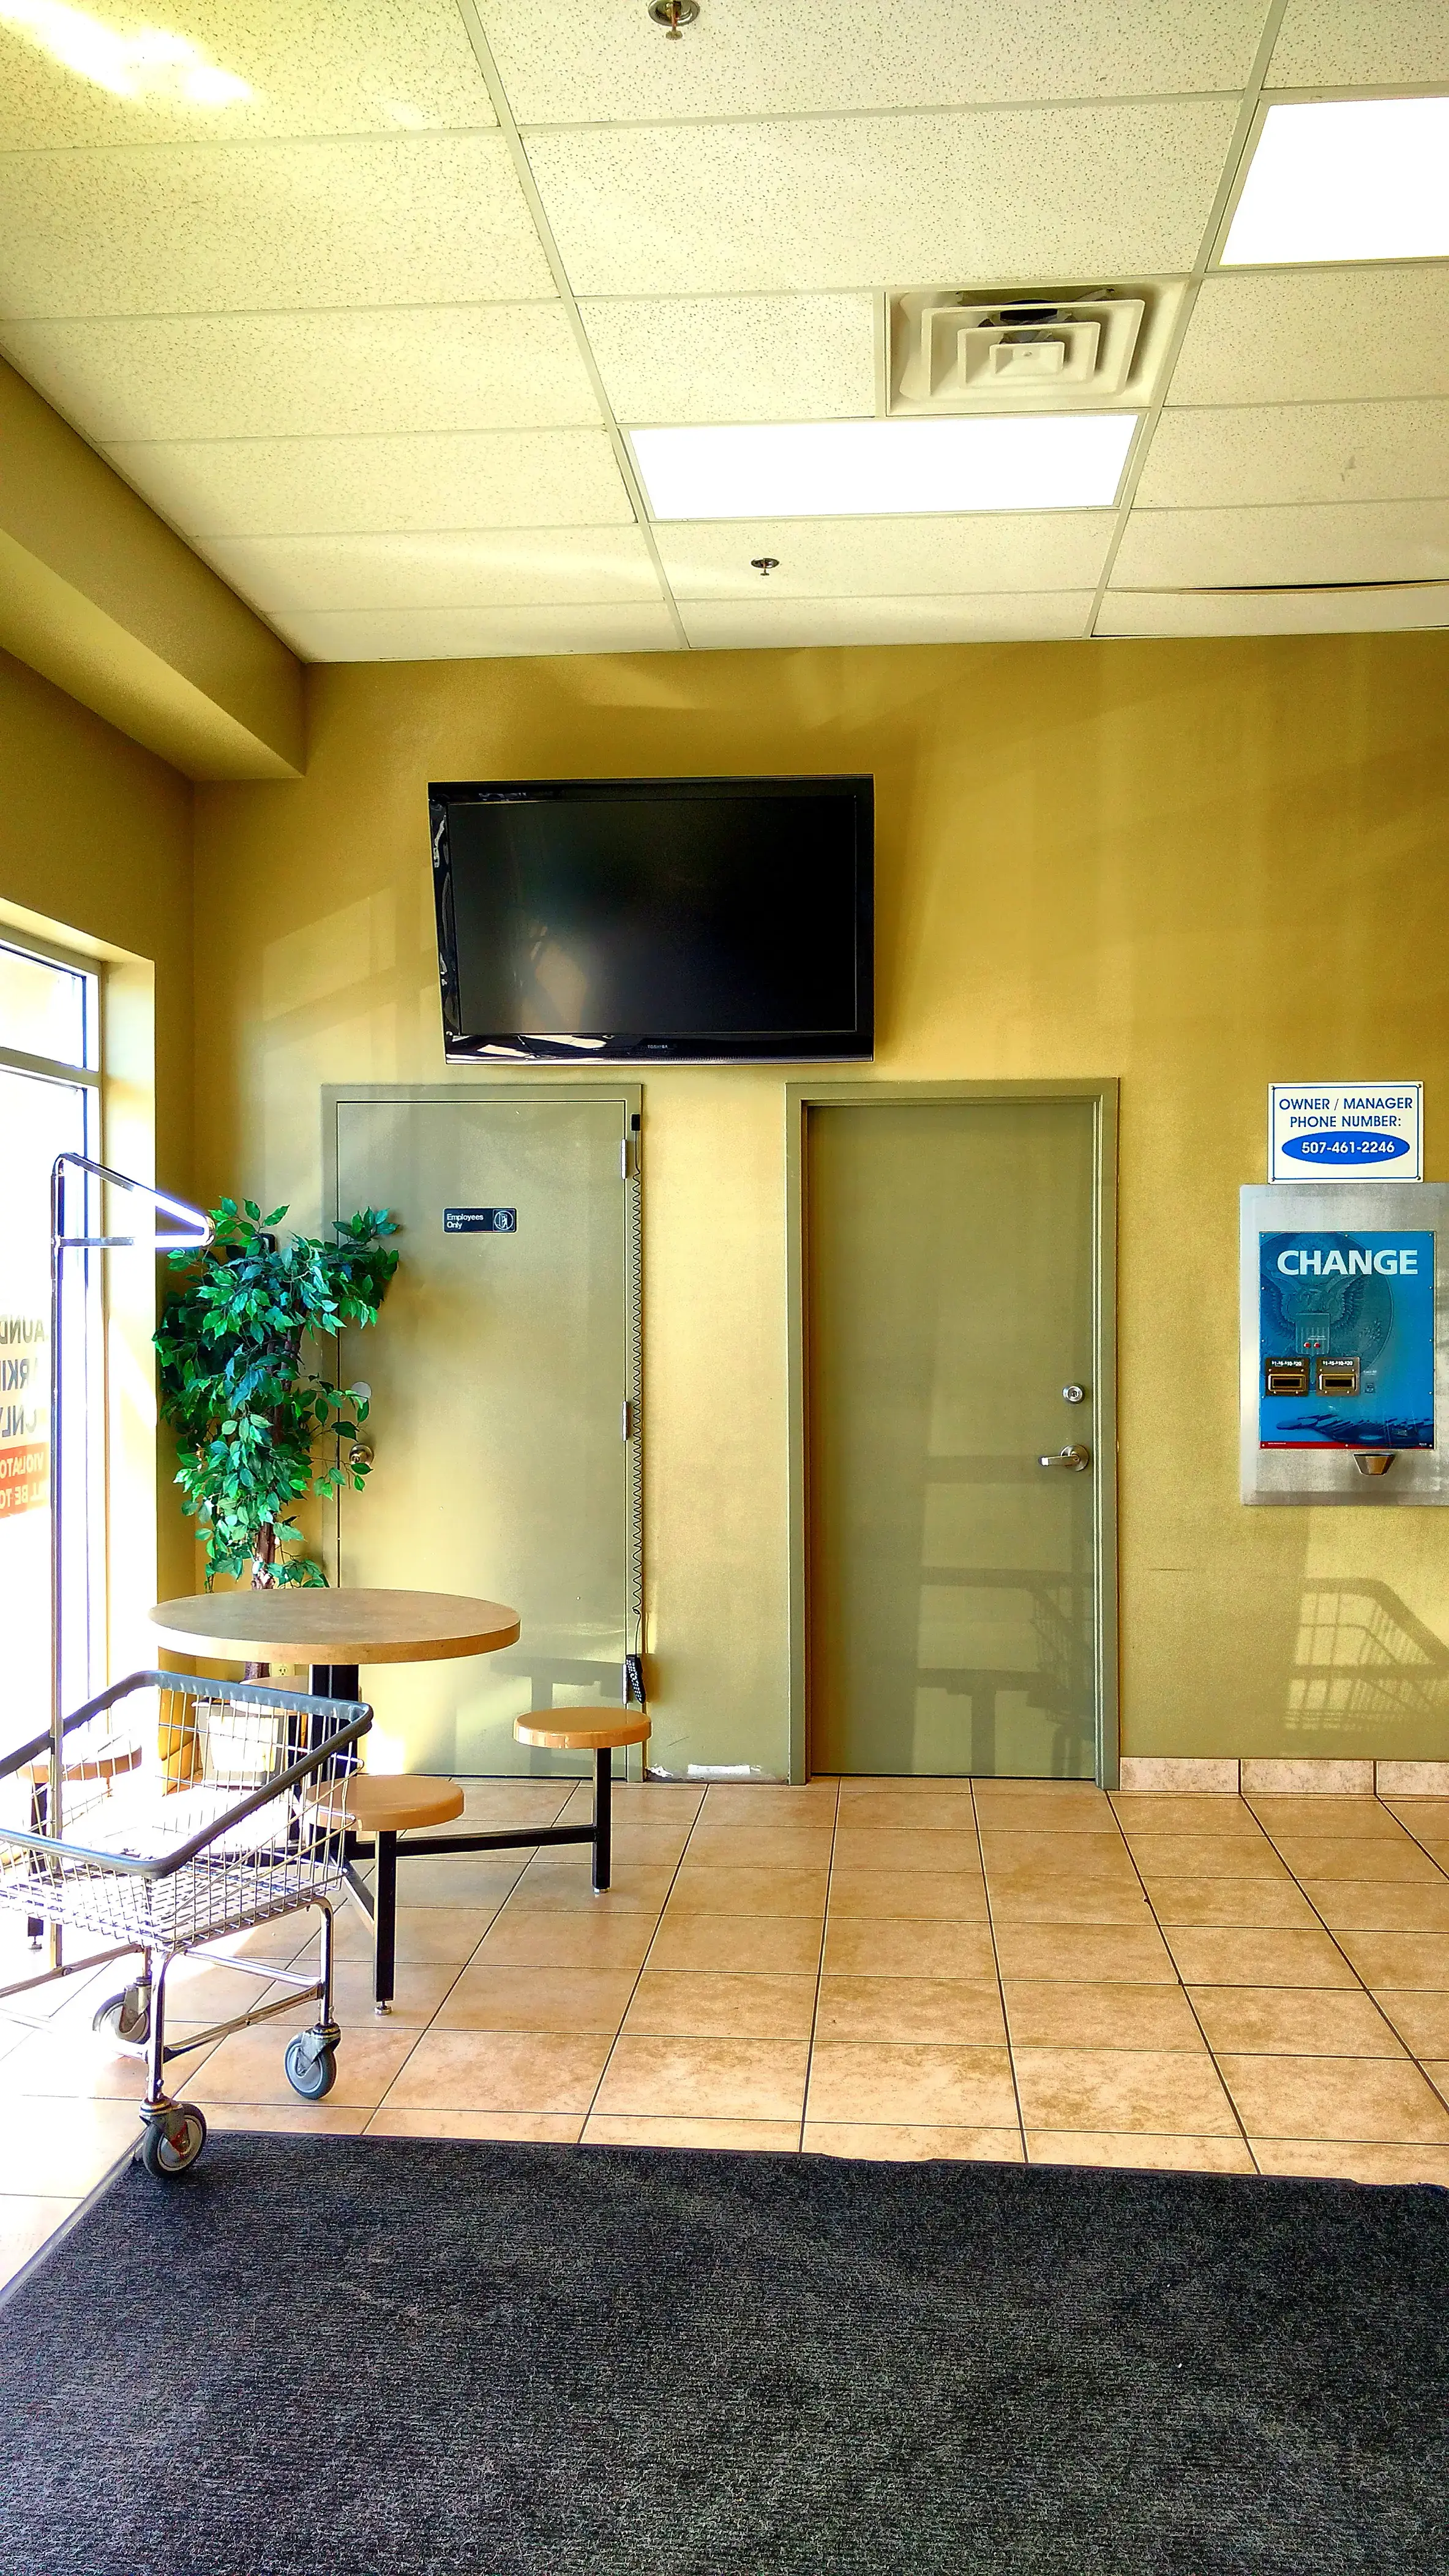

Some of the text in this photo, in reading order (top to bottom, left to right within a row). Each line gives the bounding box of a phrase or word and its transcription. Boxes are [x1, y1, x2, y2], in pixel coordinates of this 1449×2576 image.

[1279, 1098, 1413, 1110] OWNER / MANAGER
[1290, 1115, 1401, 1128] PHONE NUMBER:
[1301, 1141, 1395, 1153] 507-461-2246
[1277, 1249, 1418, 1275] CHANGE
